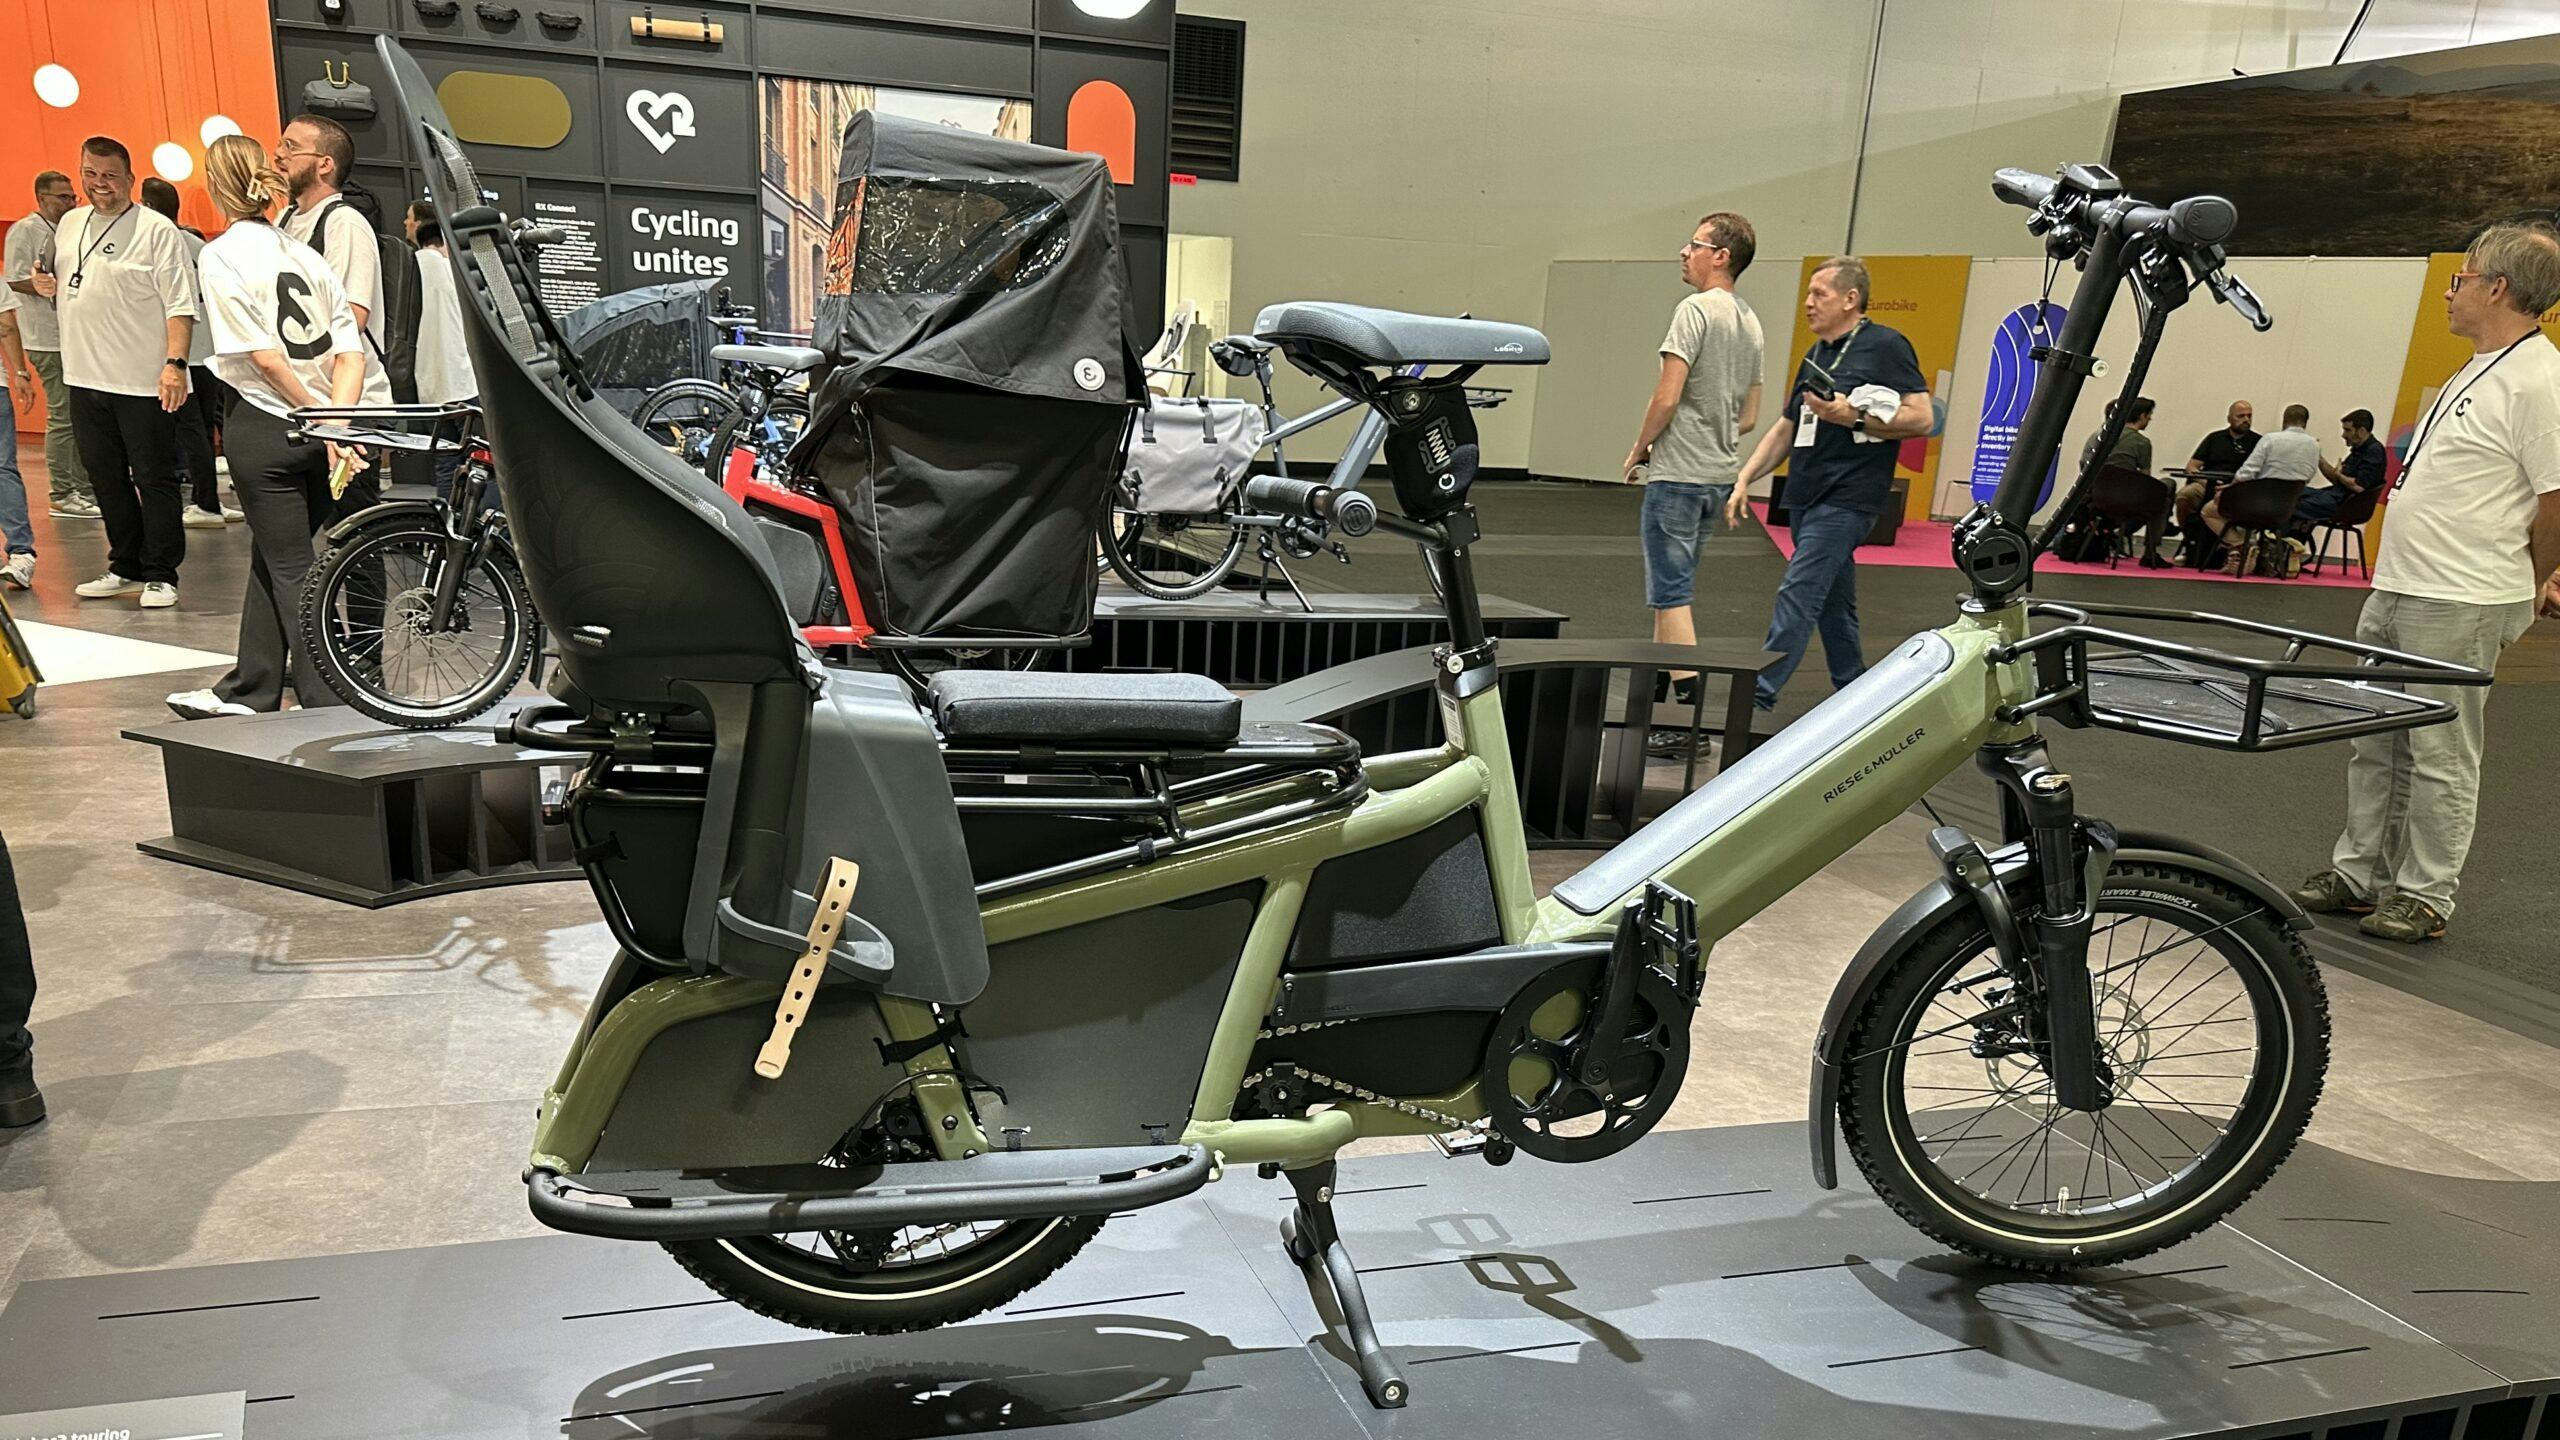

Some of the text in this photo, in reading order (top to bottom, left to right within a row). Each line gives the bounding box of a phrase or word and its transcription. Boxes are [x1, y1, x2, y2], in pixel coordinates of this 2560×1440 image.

[630, 206, 740, 247] Cycling
[632, 247, 729, 277] unites
[1982, 434, 2006, 442] directly
[1983, 424, 2004, 434] Digital
[1981, 442, 2011, 451] inventory
[1823, 770, 1863, 803] RIESE
[1872, 727, 1926, 769] MÜLLER
[2099, 888, 2192, 907] SCHWALBE SMART
